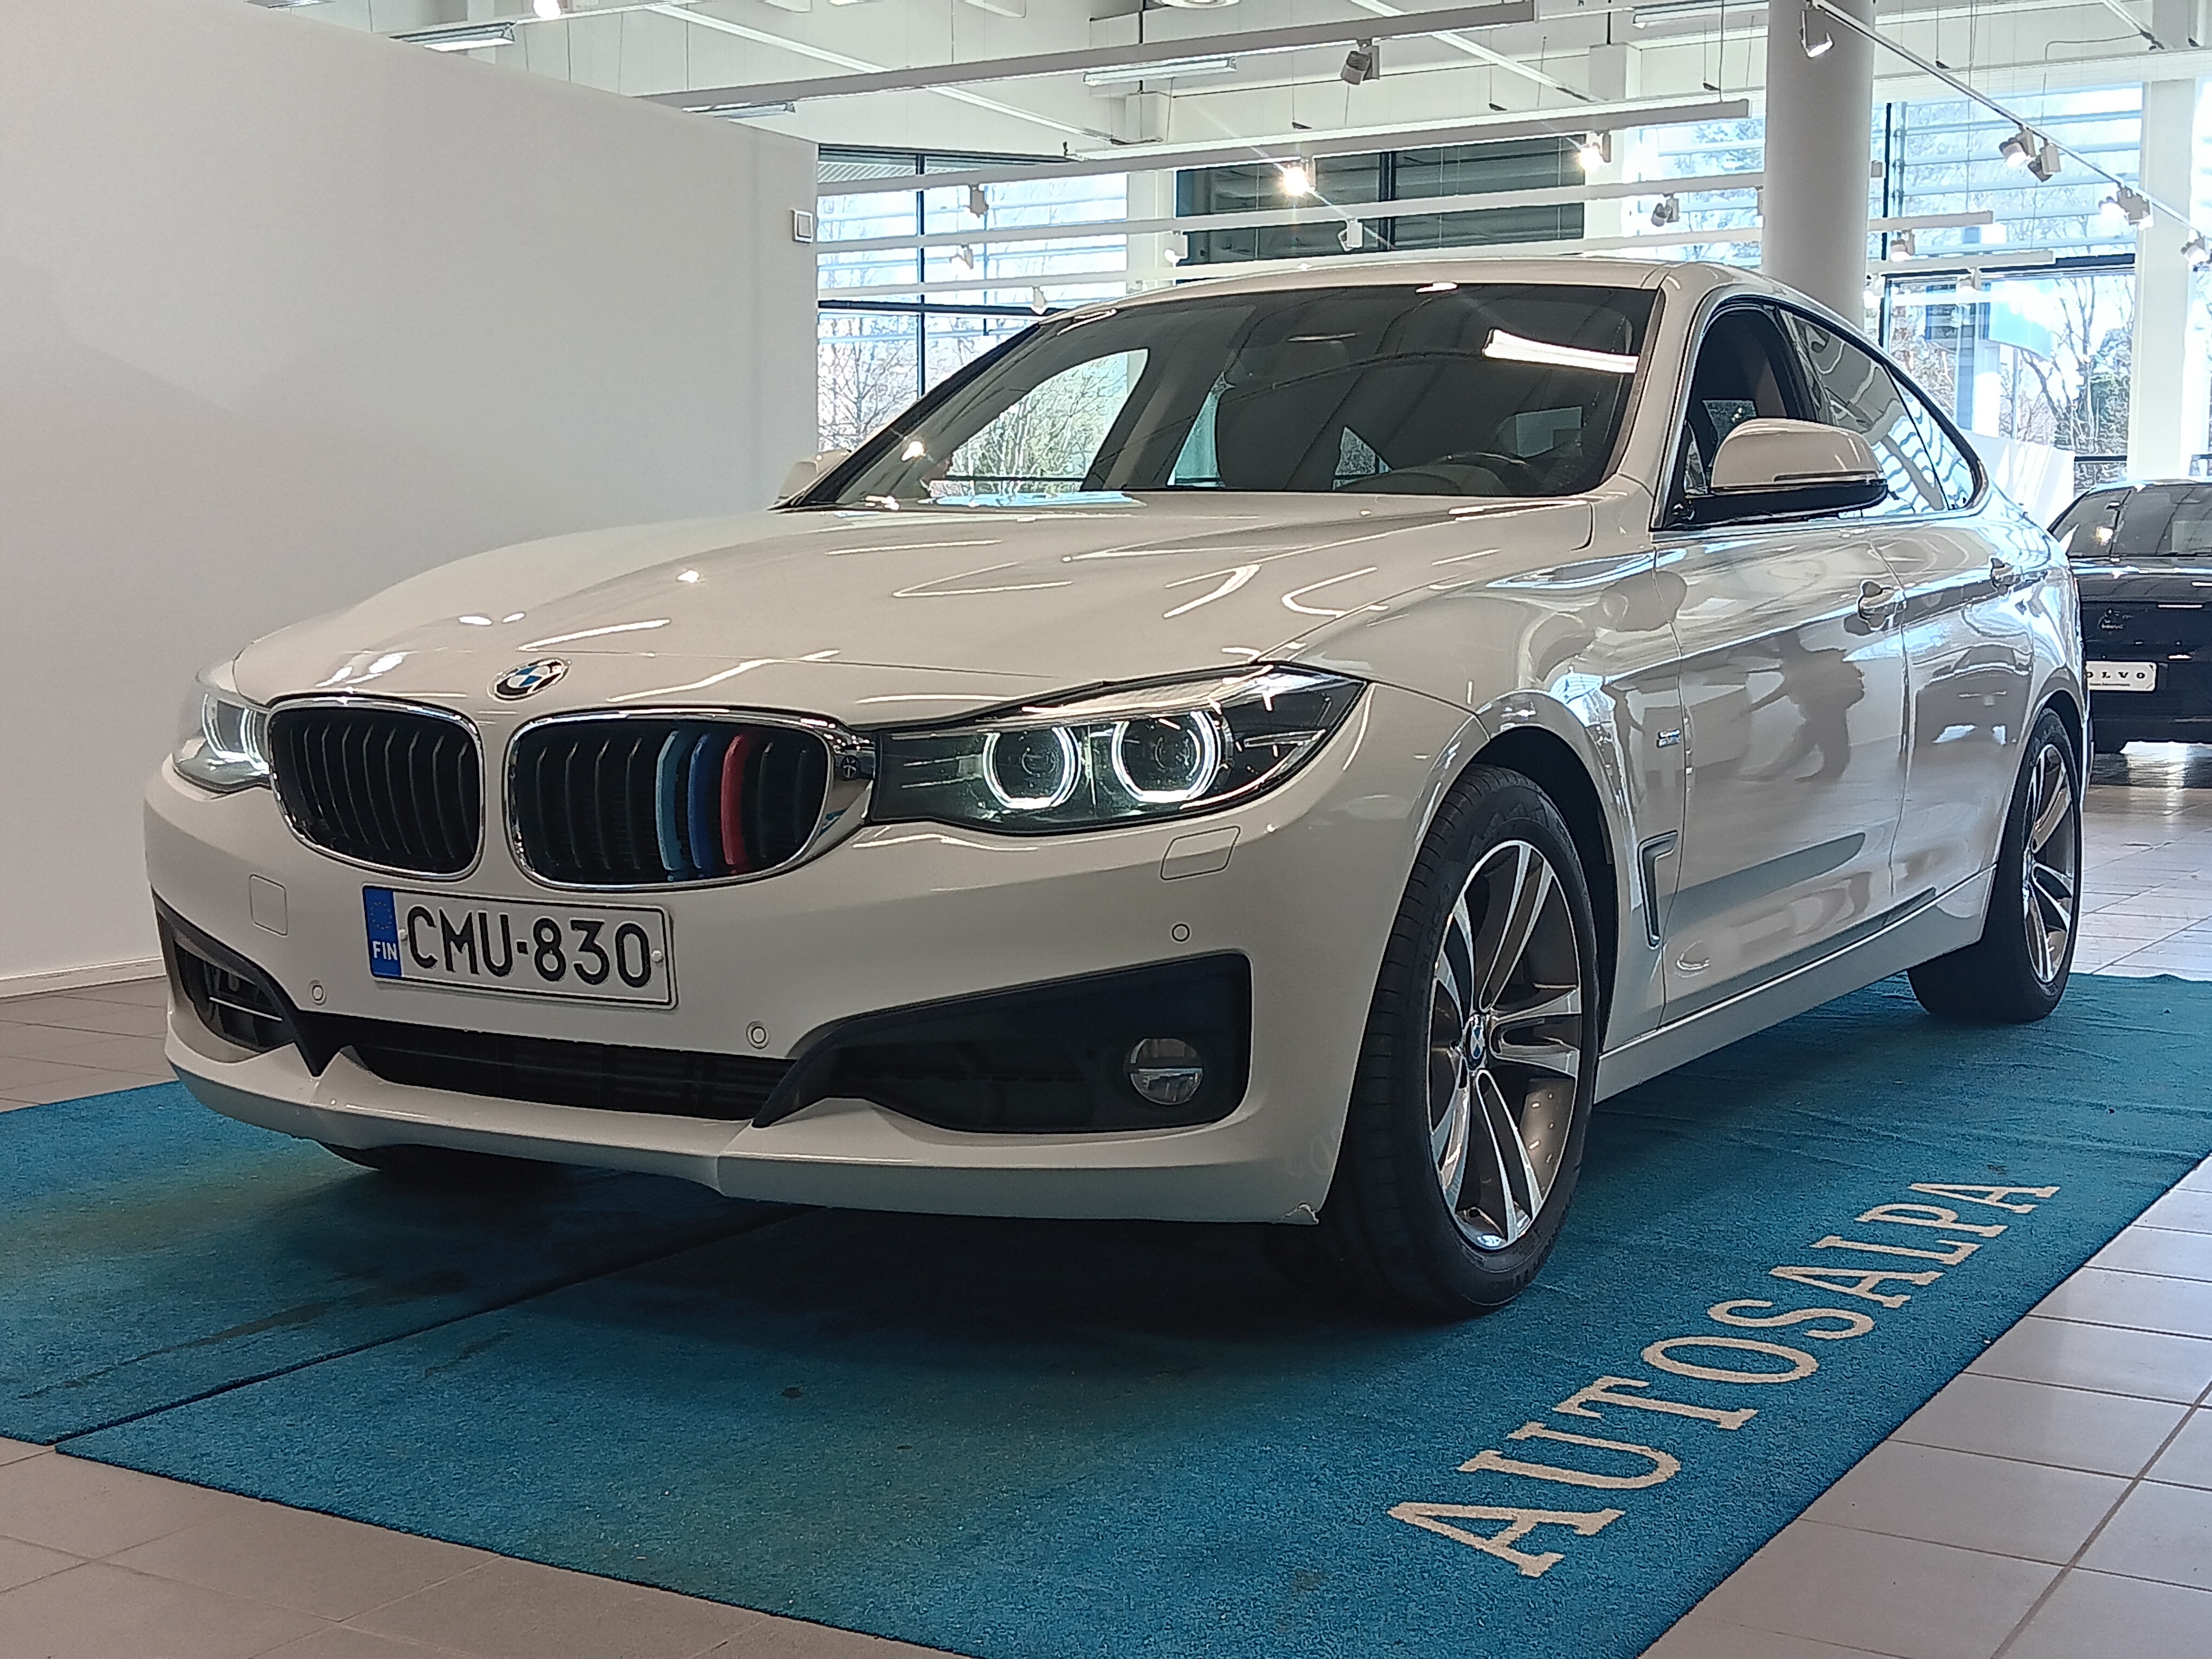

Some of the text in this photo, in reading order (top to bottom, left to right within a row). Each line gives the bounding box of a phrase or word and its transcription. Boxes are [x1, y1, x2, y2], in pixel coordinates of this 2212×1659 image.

[372, 941, 398, 961] FIN
[407, 906, 651, 988] CMU-830
[1386, 1182, 2060, 1578] AUTOSALPA
